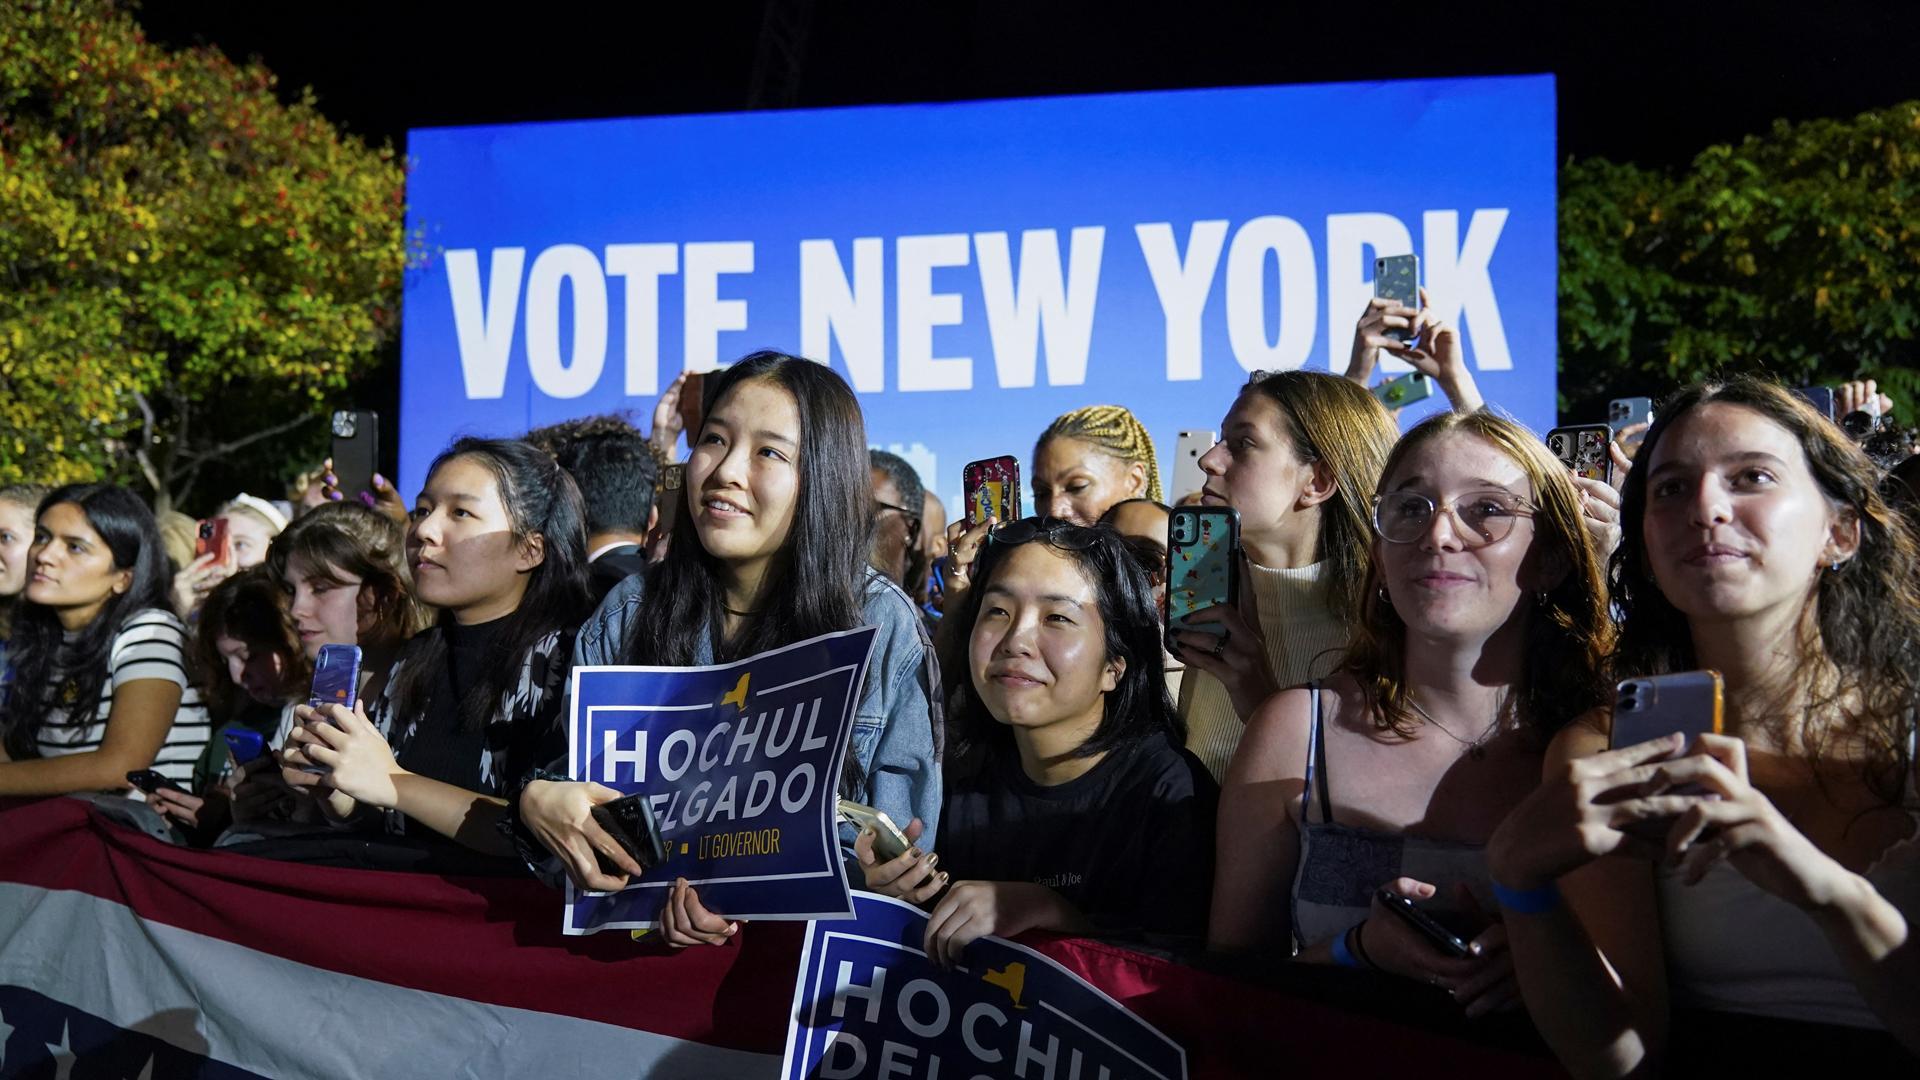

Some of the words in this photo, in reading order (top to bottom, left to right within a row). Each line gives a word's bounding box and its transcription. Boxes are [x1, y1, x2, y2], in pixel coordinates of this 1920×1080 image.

[445, 241, 754, 399] VOTE
[800, 226, 1105, 393] NEW
[603, 697, 828, 783] HOCHUL
[650, 762, 816, 832] ELGADO
[699, 835, 711, 860] LT
[712, 828, 780, 858] GOVERNOR
[1067, 872, 1082, 887] Joe
[831, 960, 1111, 1080] HOCH
